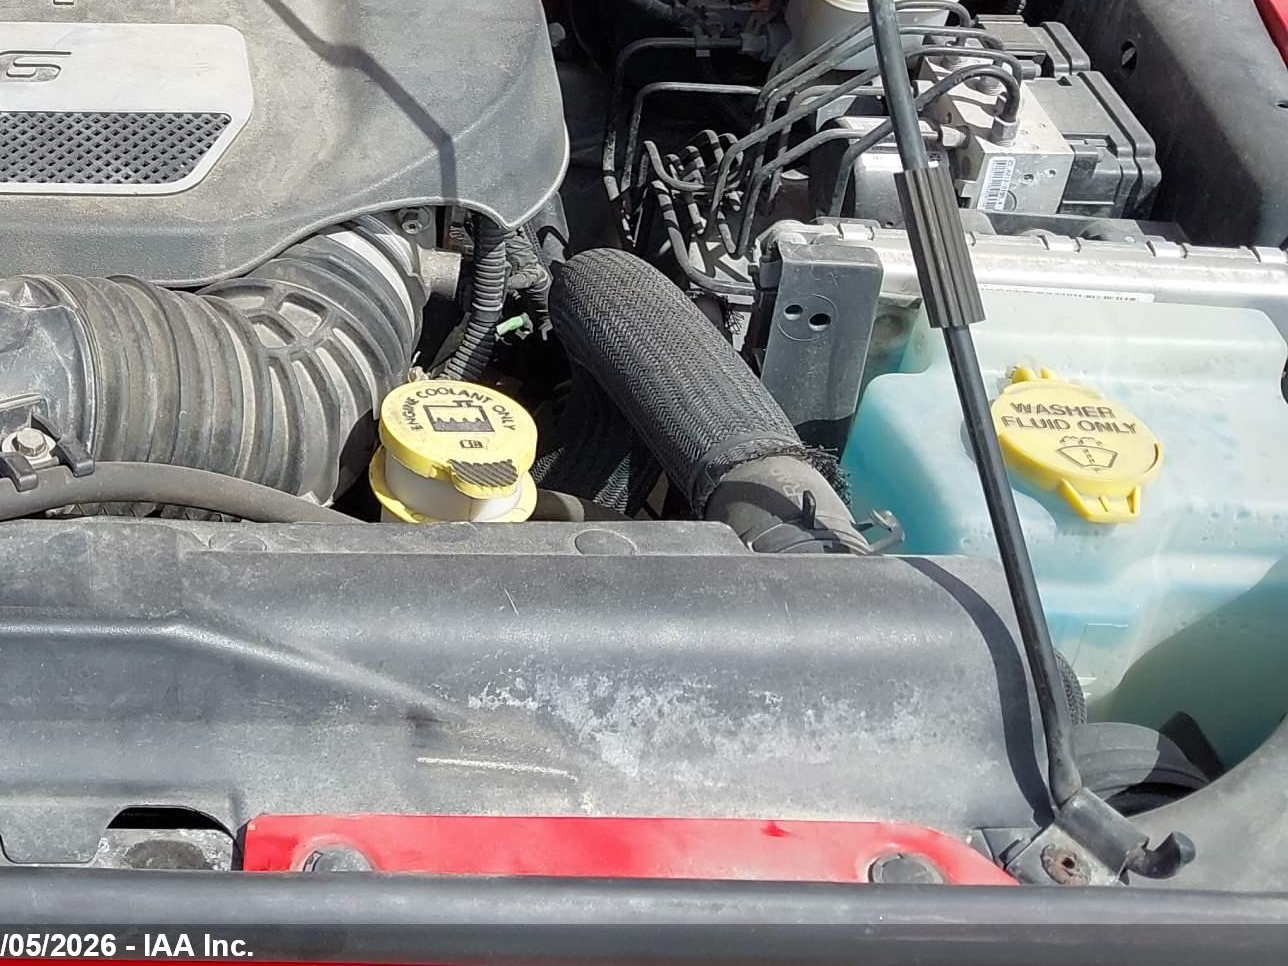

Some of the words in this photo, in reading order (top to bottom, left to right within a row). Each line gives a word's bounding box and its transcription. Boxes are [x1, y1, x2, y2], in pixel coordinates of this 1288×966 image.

[402, 397, 423, 431] ENGINE
[416, 387, 493, 404] COOLANT
[492, 405, 517, 431] ONLY
[1009, 401, 1116, 419] WASHER
[1001, 415, 1071, 431] FLUID
[1077, 419, 1137, 434] ONLY
